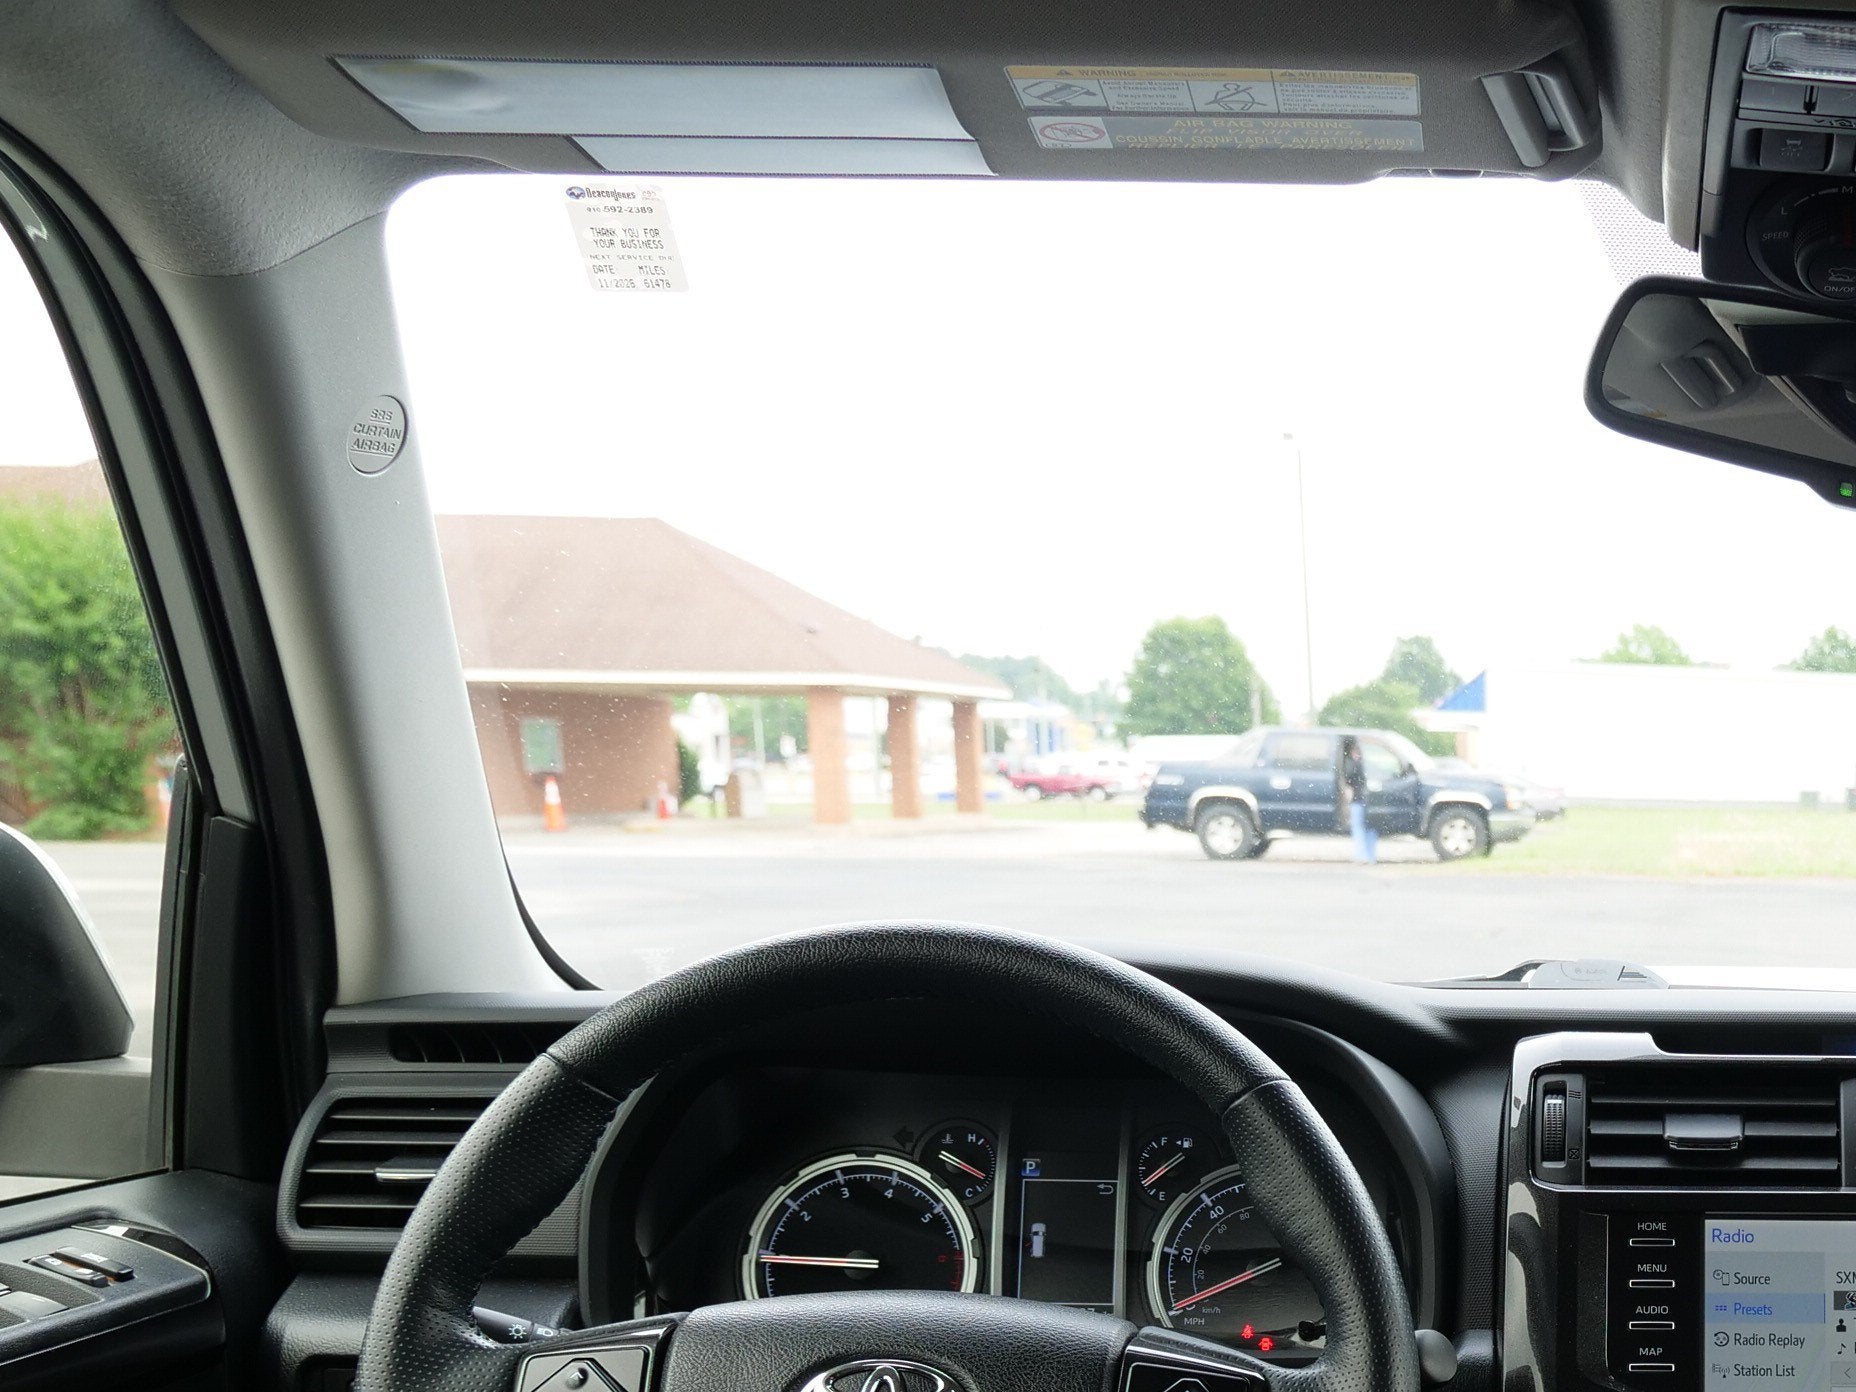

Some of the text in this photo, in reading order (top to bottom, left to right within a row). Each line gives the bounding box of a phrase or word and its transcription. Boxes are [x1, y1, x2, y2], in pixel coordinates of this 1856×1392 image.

[1213, 120, 1253, 128] BAG
[1262, 121, 1352, 129] WARNING
[1841, 186, 1853, 194] M
[1780, 207, 1788, 215] L
[590, 227, 661, 238] THANK YOU FOR
[1762, 231, 1789, 240] SPEED
[594, 239, 665, 250] YOUR BUSINESS
[592, 264, 666, 276] DATE MILES
[370, 408, 393, 420] SRS
[353, 423, 401, 439] CURTAIN
[351, 438, 396, 453] AIRBAG
[968, 1133, 976, 1143] H
[1161, 1137, 1168, 1146] F
[1025, 1161, 1036, 1174] P
[841, 1188, 850, 1199] 3
[884, 1188, 894, 1199] 4
[965, 1187, 973, 1198] C
[1159, 1192, 1166, 1201] E
[800, 1210, 813, 1223] 2
[921, 1213, 932, 1223] 5
[1209, 1205, 1224, 1221] 40
[1239, 1212, 1251, 1222] 80
[1217, 1224, 1228, 1235] 60
[1637, 1222, 1667, 1231] HOME
[1711, 1228, 1755, 1244] Radio
[1181, 1247, 1194, 1263] 20
[1637, 1263, 1667, 1273] MENU
[1733, 1271, 1771, 1285] Source
[1635, 1305, 1669, 1314] AUDIO
[1733, 1302, 1773, 1316] Presets
[1184, 1317, 1205, 1326] MPH
[1733, 1332, 1806, 1349] Radio Replay
[1639, 1347, 1663, 1356] MAP
[1733, 1363, 1796, 1377] Station List
